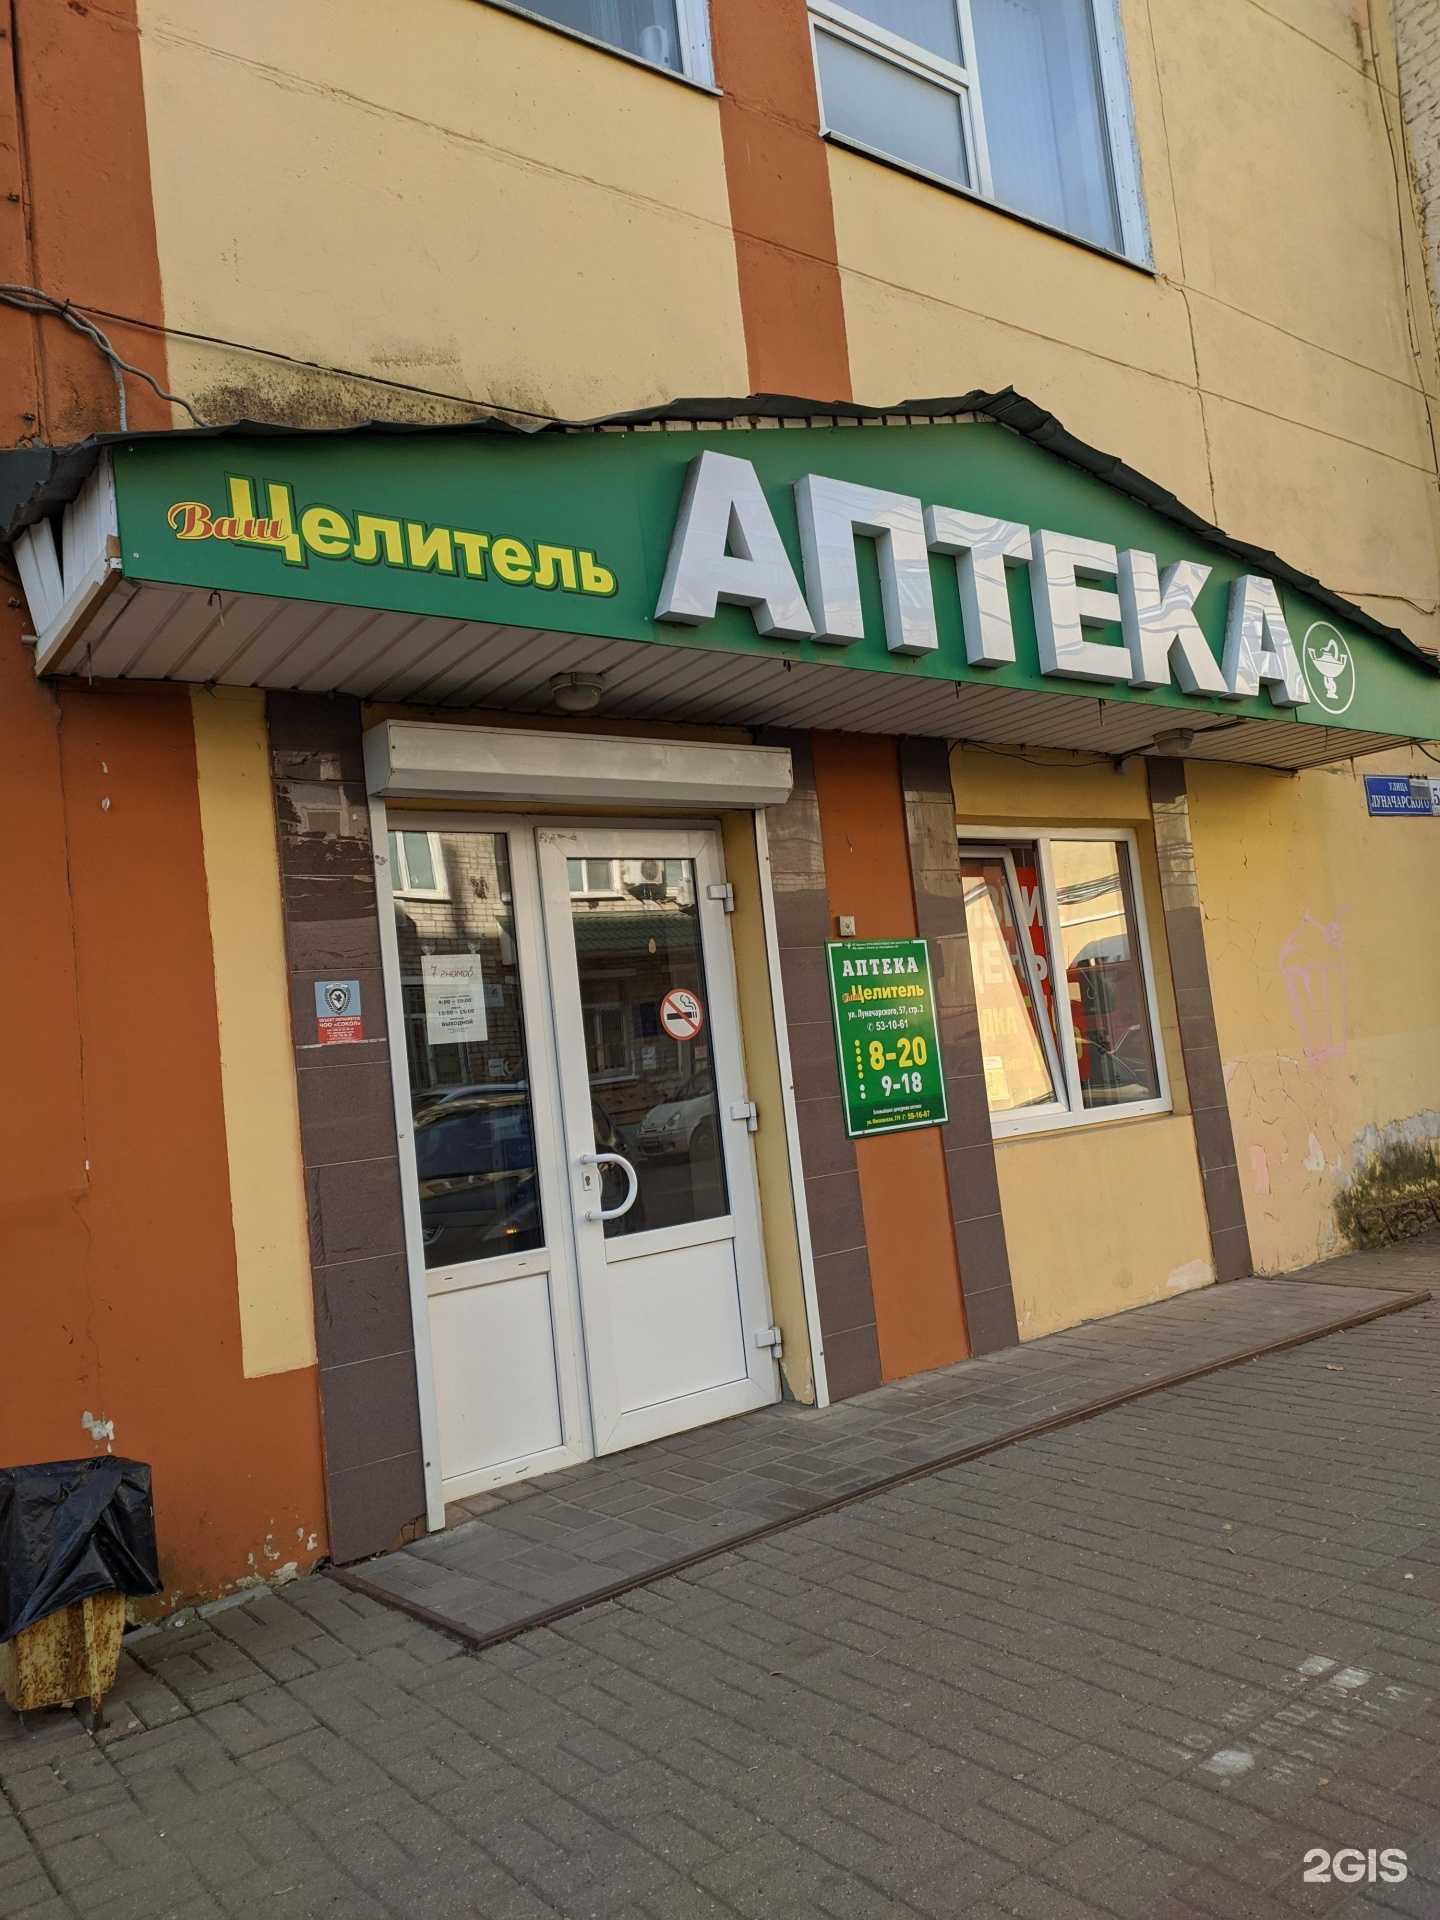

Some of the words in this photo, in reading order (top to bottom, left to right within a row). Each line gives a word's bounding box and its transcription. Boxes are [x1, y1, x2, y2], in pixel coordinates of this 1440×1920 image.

[167, 501, 290, 540] Ваш
[224, 472, 617, 597] Целитель
[654, 450, 1311, 708] АПТЕКА
[842, 957, 919, 977] АПТЕКА
[851, 985, 924, 1003] Целитель
[876, 1019, 908, 1031] 53-10-61
[868, 1036, 928, 1071] 8-20
[881, 1072, 922, 1097] 9-18
